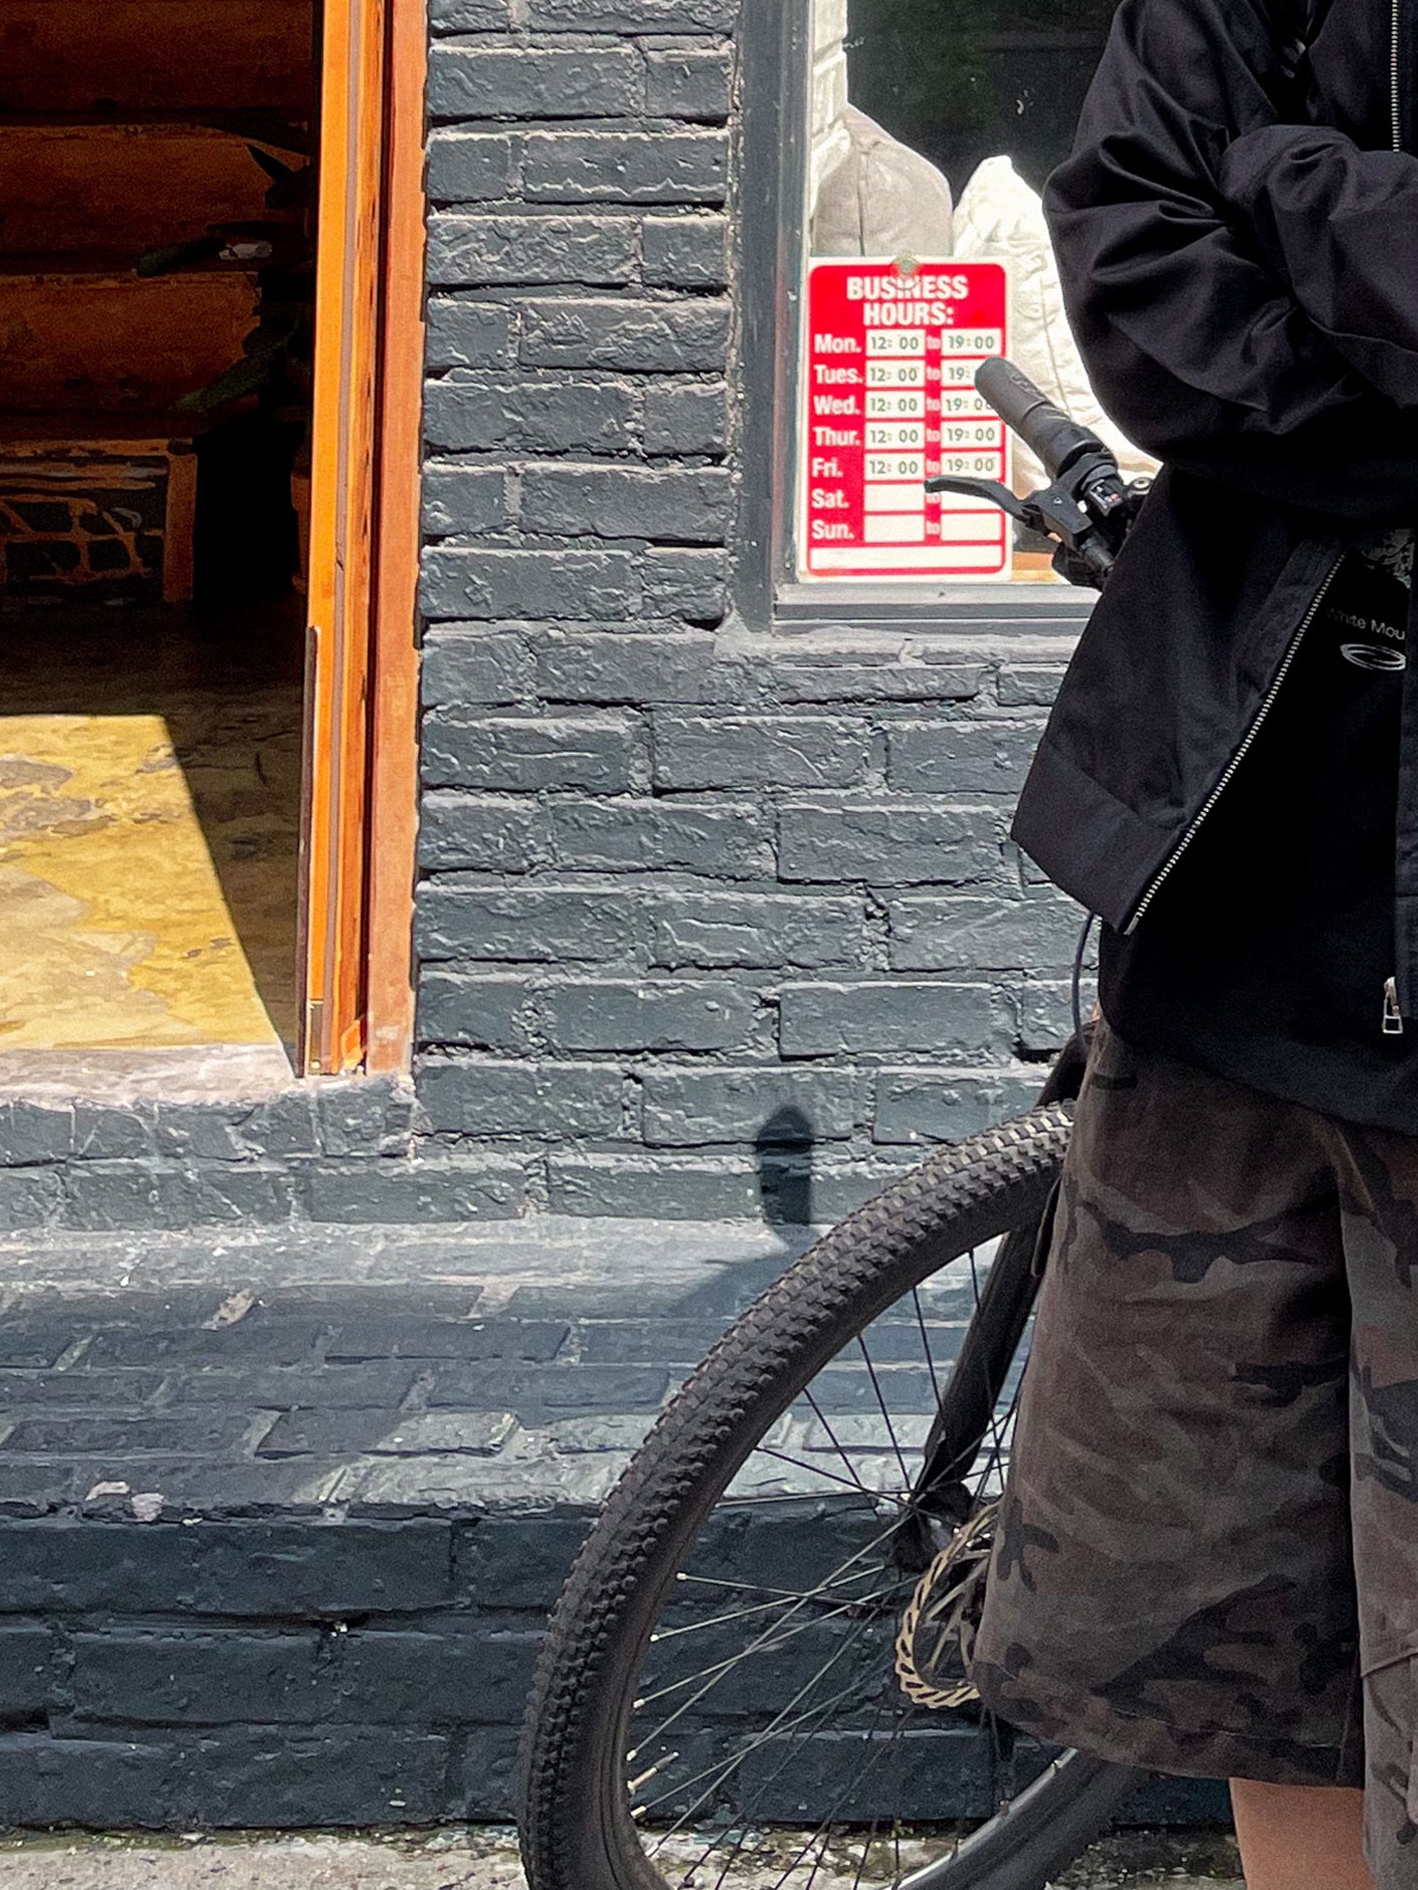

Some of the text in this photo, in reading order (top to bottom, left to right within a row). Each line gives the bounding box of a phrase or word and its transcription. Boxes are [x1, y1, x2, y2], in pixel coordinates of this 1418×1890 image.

[846, 275, 969, 300] BUSINESS
[863, 302, 955, 326] HOURS:
[814, 333, 862, 353] Mon.
[926, 336, 941, 350] to
[948, 335, 995, 349] 19:00
[814, 364, 864, 384] Tues.
[926, 367, 941, 381] to
[813, 395, 861, 415] Wed.
[926, 397, 941, 411] to
[813, 426, 861, 447] Thur.
[926, 428, 941, 442] to
[812, 457, 843, 478] Fri.
[926, 459, 941, 474] to
[811, 488, 849, 508] Sat.
[811, 520, 941, 540] Sun. to
